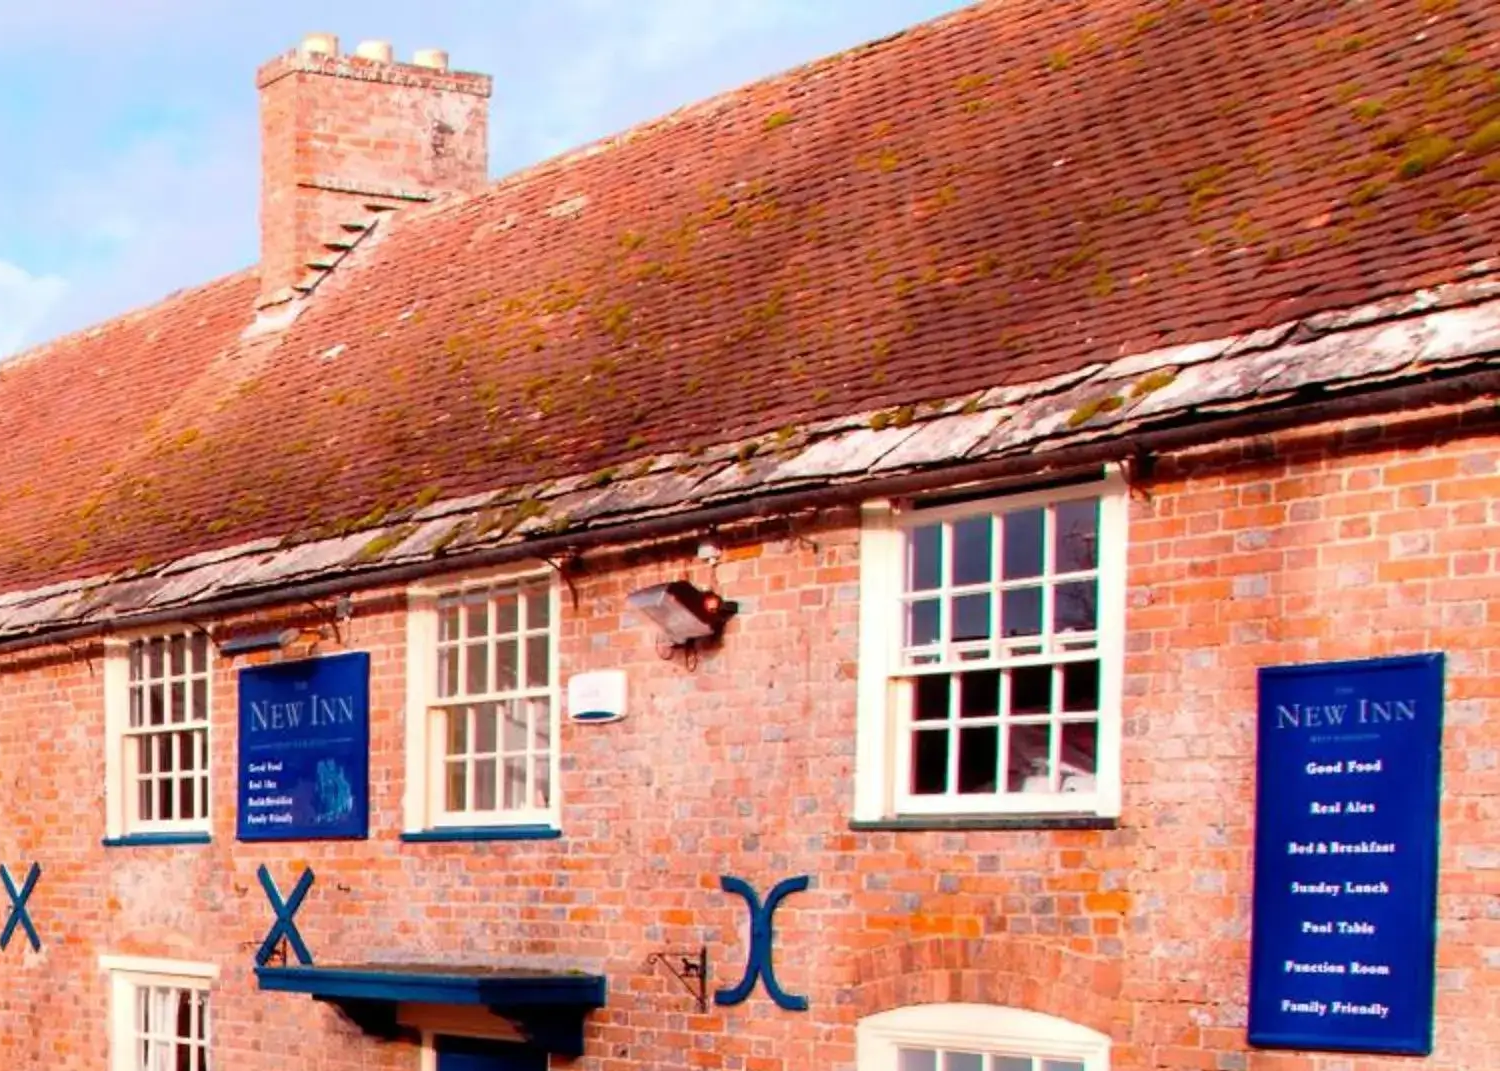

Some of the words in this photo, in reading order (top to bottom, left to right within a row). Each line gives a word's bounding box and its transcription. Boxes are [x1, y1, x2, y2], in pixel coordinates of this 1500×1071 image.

[250, 700, 304, 732] NEW
[310, 694, 353, 726] INN
[1275, 703, 1348, 729] NEW
[1357, 698, 1416, 724] INN
[1306, 761, 1342, 775] Good
[1348, 760, 1382, 772] Food
[1310, 802, 1341, 814] Real
[1345, 802, 1375, 813] Ales
[1287, 841, 1314, 854] Bed
[1316, 841, 1328, 854] &
[1330, 841, 1395, 854] Breakfast
[1291, 881, 1340, 896] Sunday
[1345, 881, 1389, 894] Lunch
[1302, 921, 1332, 933] Pool
[1337, 921, 1375, 934] Table
[1284, 960, 1345, 974] Function
[1350, 961, 1390, 975] Room
[1281, 999, 1327, 1016] Family
[1332, 1002, 1389, 1019] Friendly
